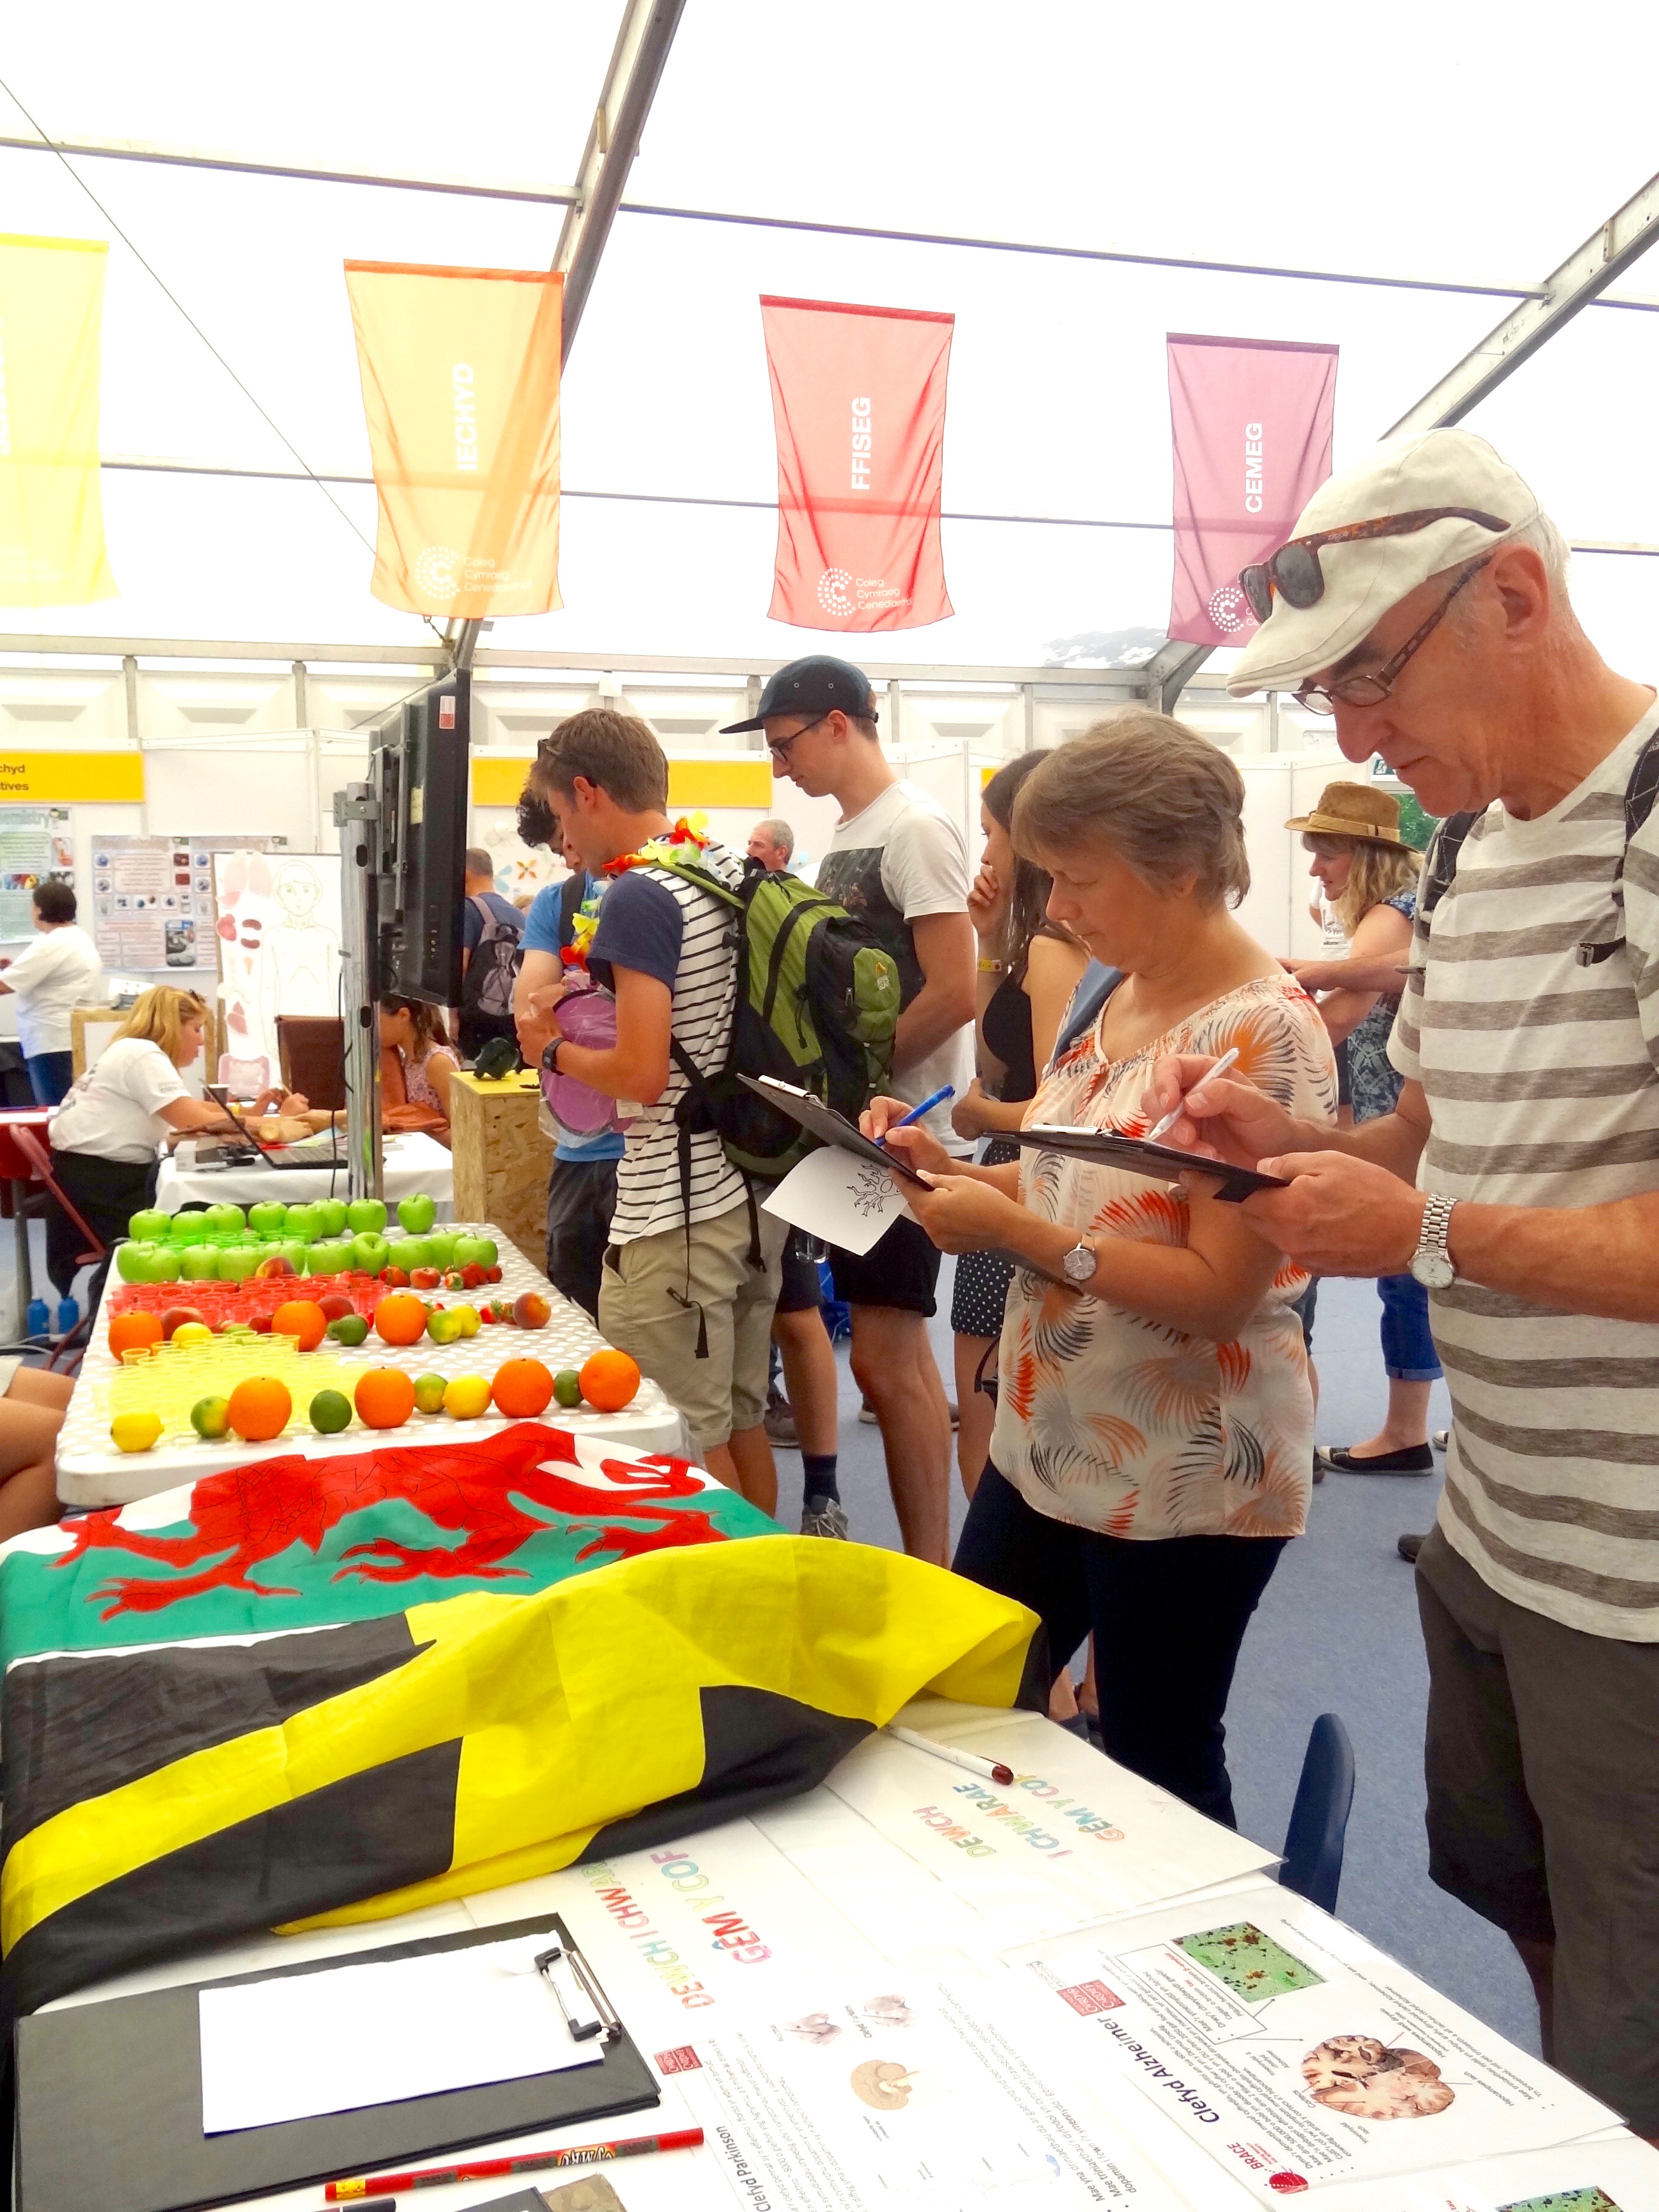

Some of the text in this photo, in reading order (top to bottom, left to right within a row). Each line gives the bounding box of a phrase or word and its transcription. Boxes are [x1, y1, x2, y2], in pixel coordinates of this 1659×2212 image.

[452, 363, 478, 471] IECHYD
[851, 397, 871, 490] FFISEG
[1245, 423, 1262, 513] CEMEG
[856, 578, 885, 588] Coleg
[857, 588, 900, 599] Cymraeg
[913, 1806, 997, 1858] DEWCH
[953, 1782, 1060, 1850] CHWARAE
[581, 1860, 649, 1931] CHWAR
[649, 1851, 709, 1892] COF
[637, 1939, 716, 2009] DEWCH
[1081, 1983, 1116, 2008] CARDIFF
[1097, 2018, 1220, 2122] Clefyd Alzheimer
[1292, 2090, 1316, 2108] Cortecs
[715, 2126, 772, 2212] Clefyd Parkinson
[1227, 2142, 1264, 2169] BRACE
